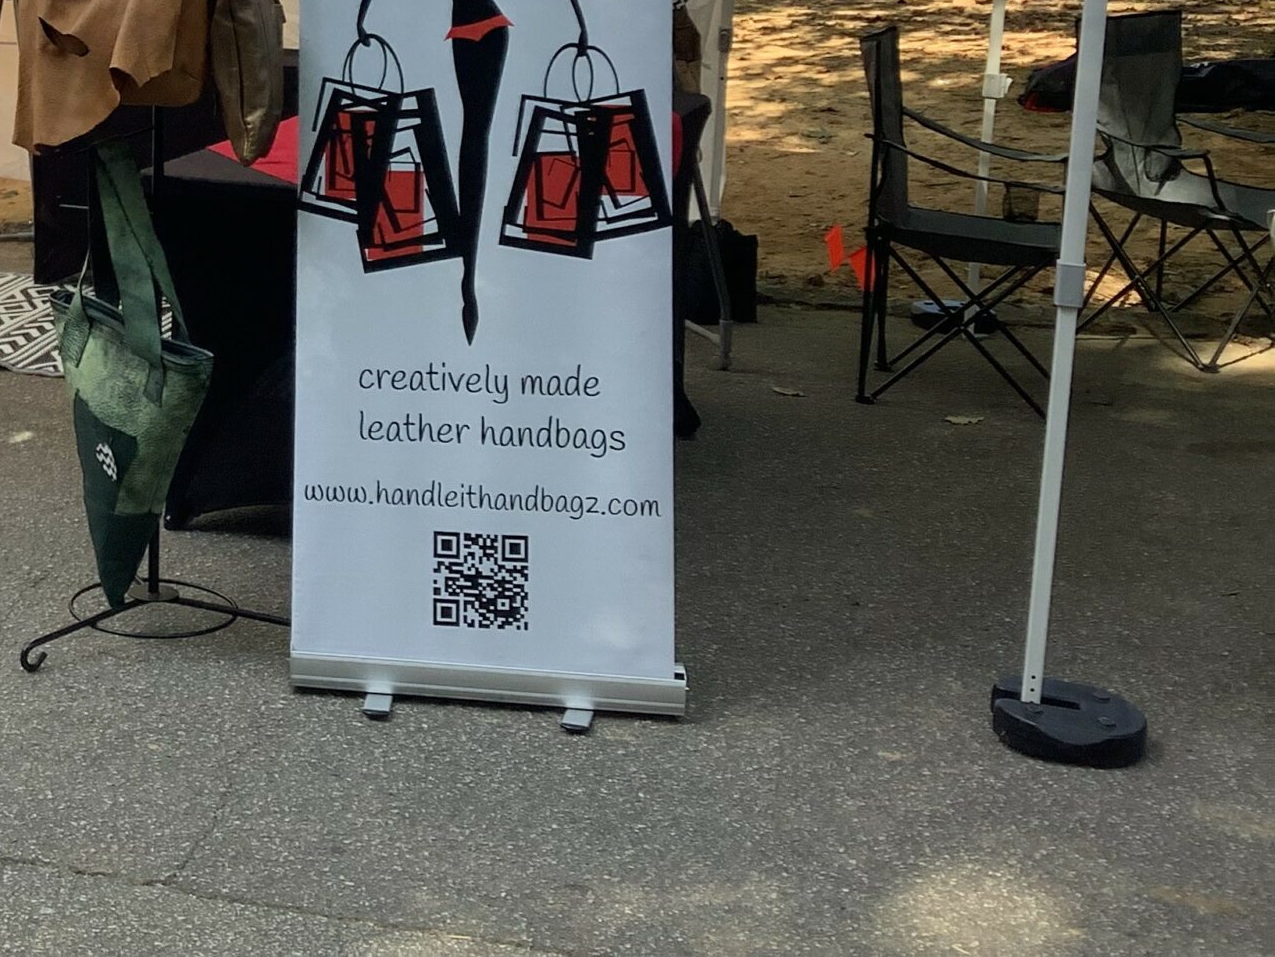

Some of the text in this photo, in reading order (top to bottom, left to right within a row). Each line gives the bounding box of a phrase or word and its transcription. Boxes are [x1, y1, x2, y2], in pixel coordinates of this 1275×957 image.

[358, 362, 601, 405] creatively made
[359, 410, 627, 459] leather handbags
[303, 479, 663, 521] www.handleithandbagz.com
